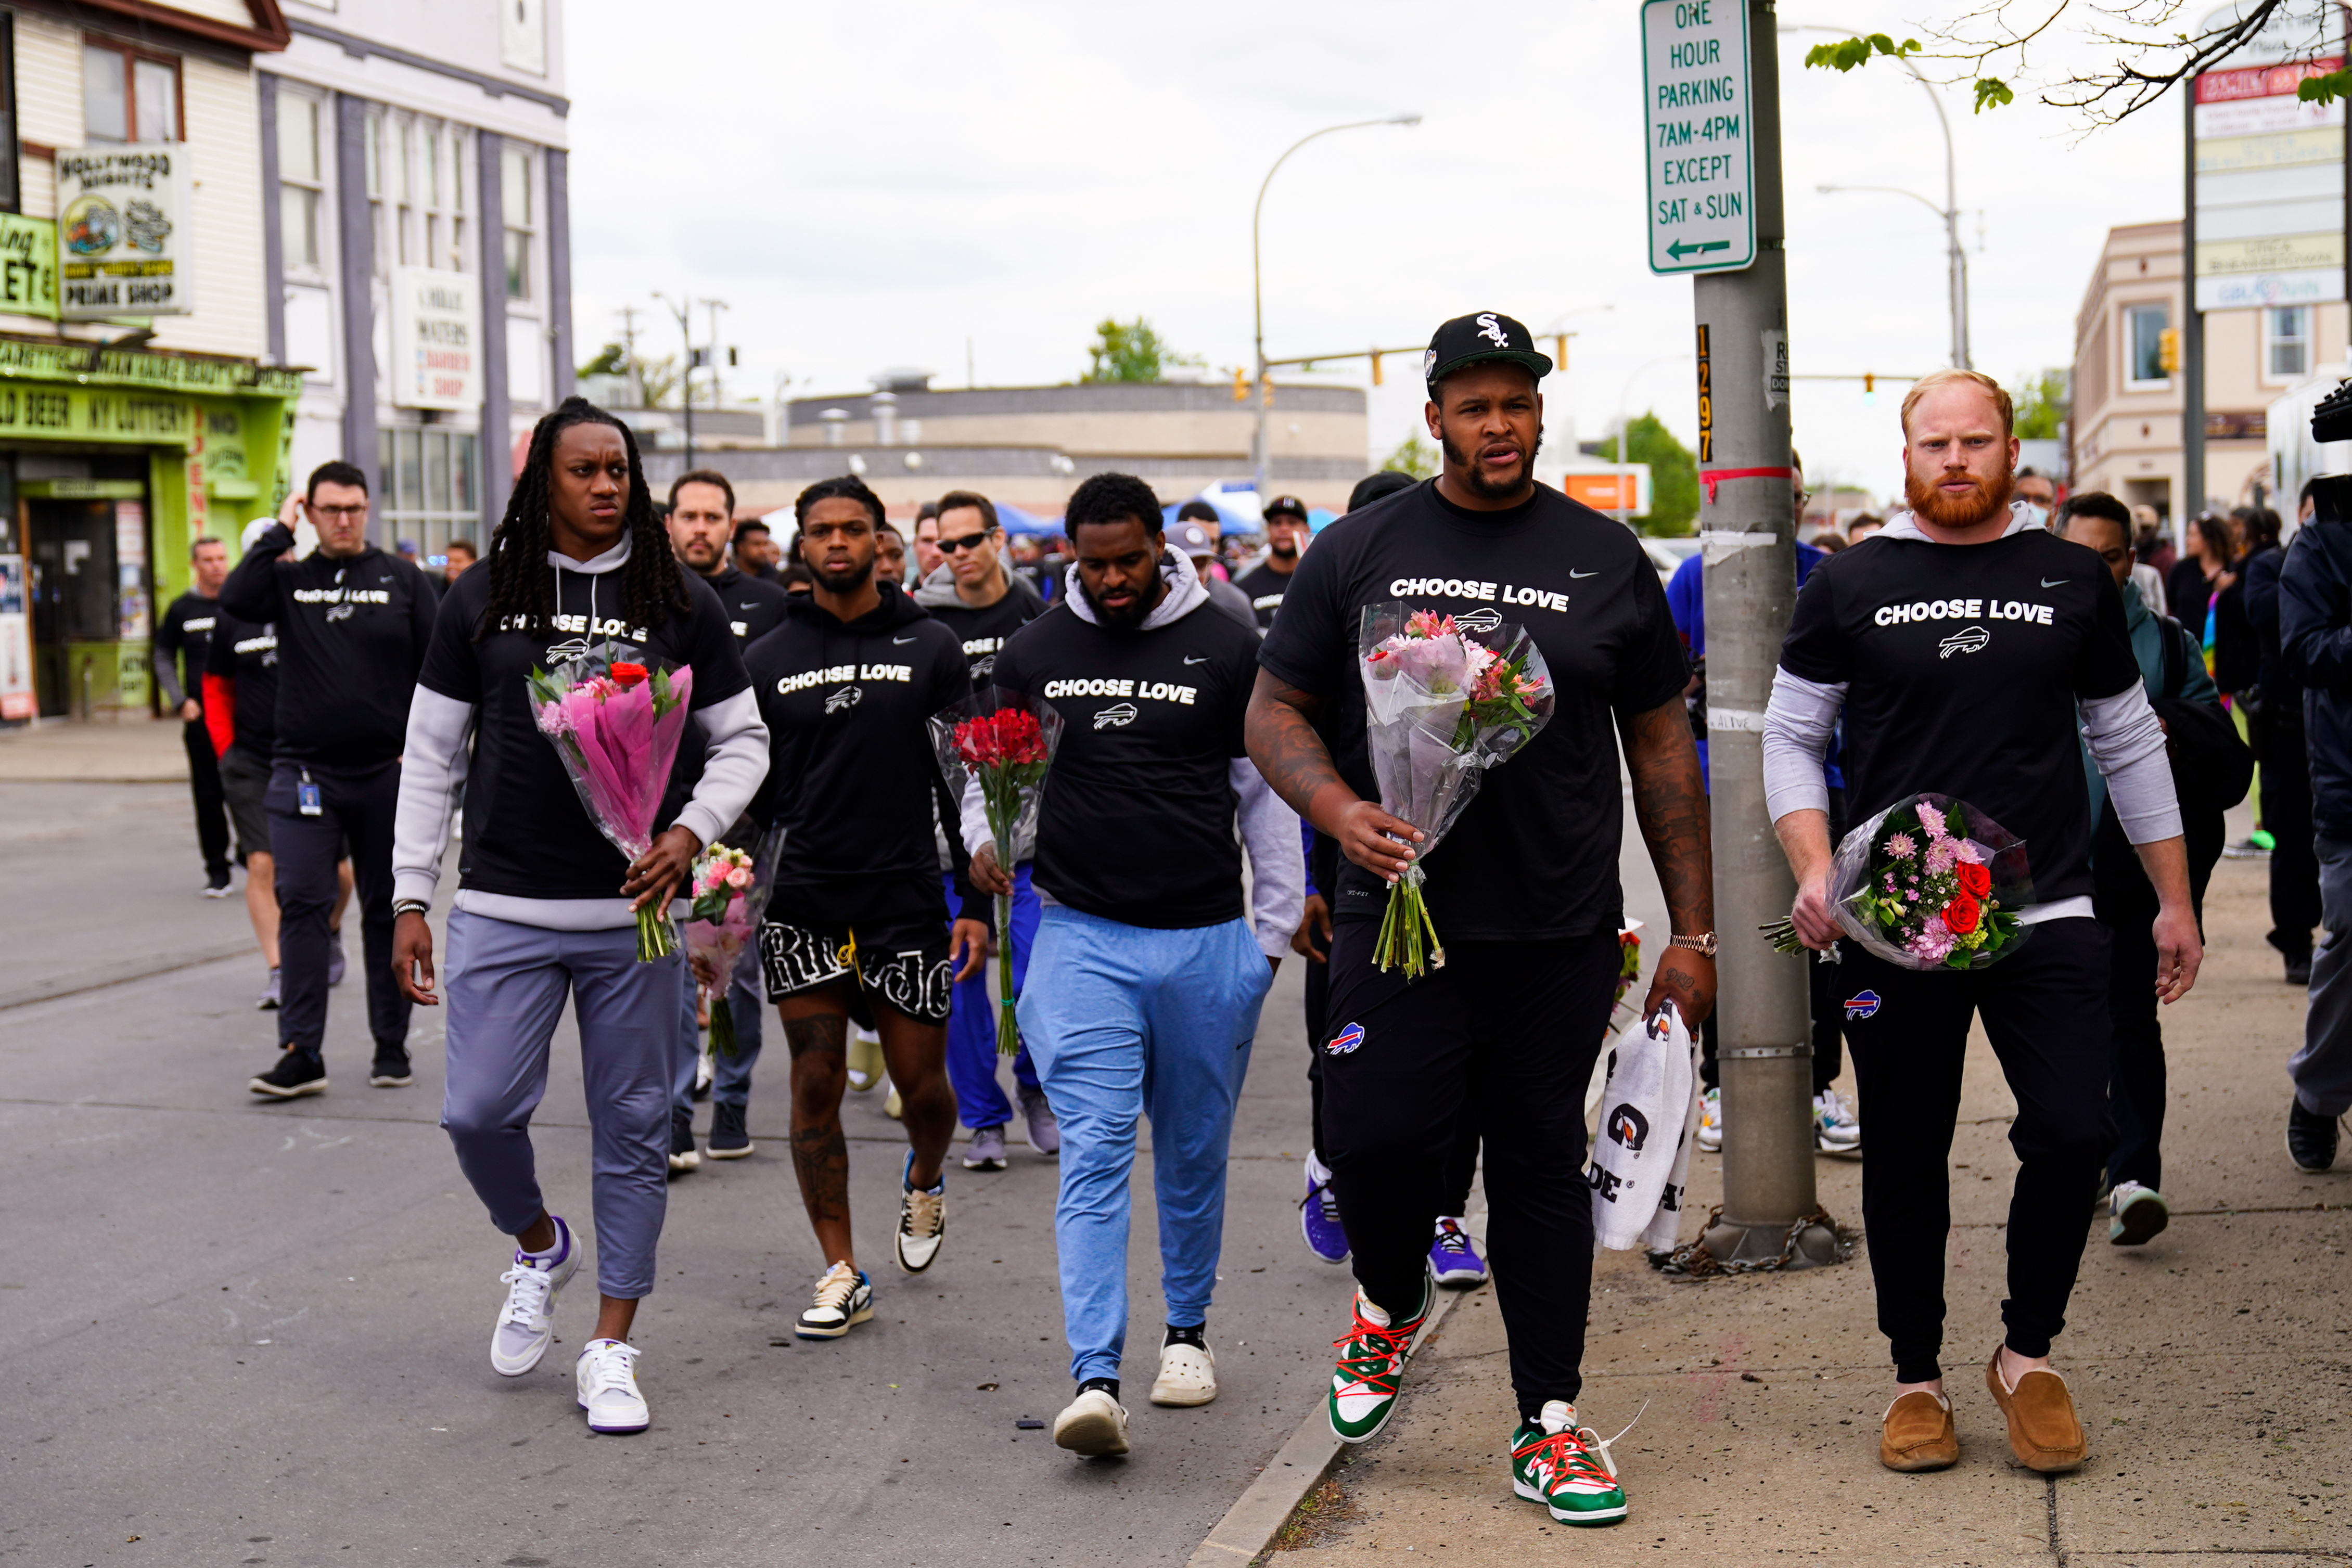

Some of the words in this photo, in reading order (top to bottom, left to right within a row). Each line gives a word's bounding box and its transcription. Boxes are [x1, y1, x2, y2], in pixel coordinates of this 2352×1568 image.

[1676, 1, 1712, 29] ONE
[1671, 39, 1720, 69] HOUR
[1658, 76, 1733, 109] PARKING
[1657, 114, 1740, 148] 7AM-4PM
[60, 155, 170, 181] HOLLYWOOD
[1664, 155, 1732, 185] EXCEPT
[1658, 198, 1688, 225] SAT
[1694, 202, 1702, 214] &
[1707, 191, 1742, 219] SUN
[129, 284, 173, 303] SHOP
[1476, 313, 1509, 348] Sox
[1698, 326, 1712, 462] 1297
[26, 393, 69, 427] BEER
[1389, 578, 1498, 601] CHOOSE
[1502, 584, 1569, 612] LOVE
[1875, 599, 1983, 626] CHOOSE
[1989, 599, 2054, 625] LOVE
[860, 664, 912, 682] LOVE
[1044, 678, 1134, 698] CHOOSE
[1138, 681, 1197, 705] LOVE
